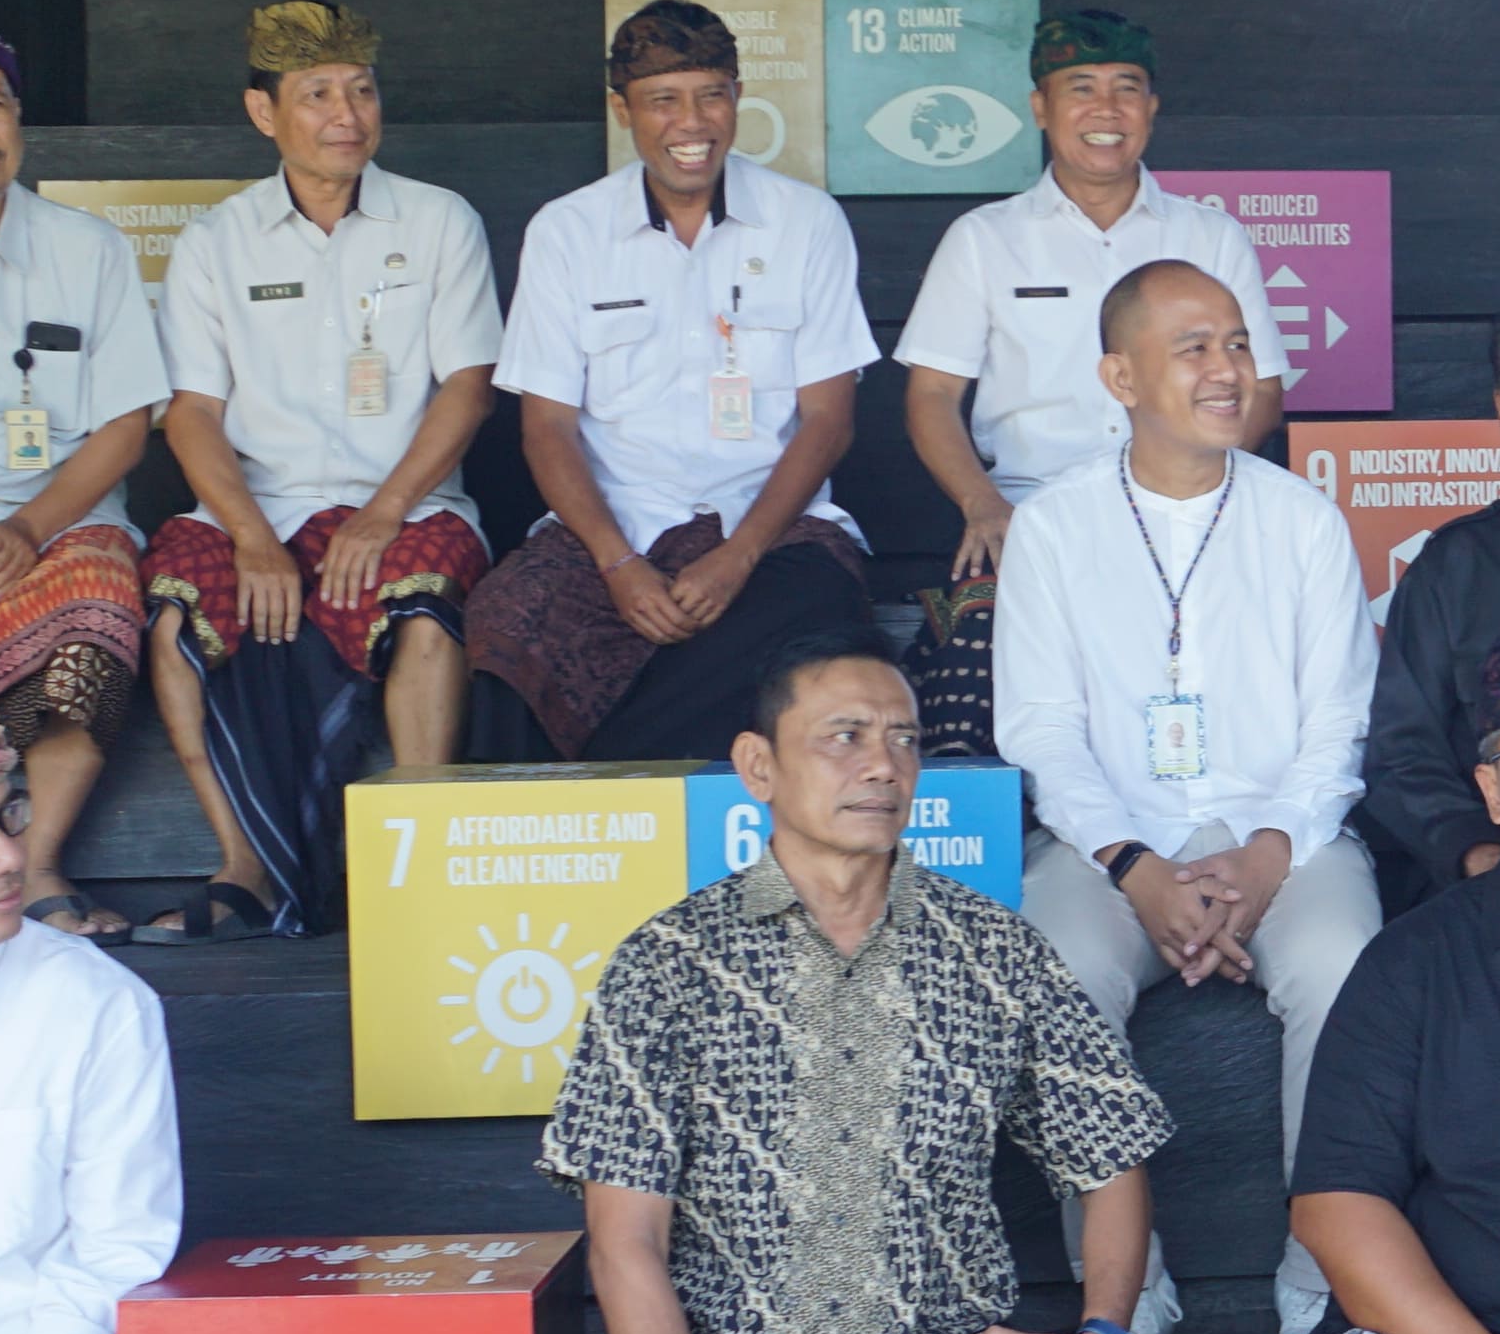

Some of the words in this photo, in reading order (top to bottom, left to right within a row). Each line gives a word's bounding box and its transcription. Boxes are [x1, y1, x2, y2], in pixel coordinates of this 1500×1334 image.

[719, 11, 777, 29] NSIBLE
[898, 8, 963, 27] CLIMATE
[847, 7, 886, 54] 13
[899, 33, 956, 53] ACTION
[739, 62, 806, 80] DUCTION
[1239, 194, 1318, 216] REDUCED
[1243, 223, 1350, 247] NEQUALITIES
[1350, 449, 1443, 476] INDUSTRY,
[1306, 450, 1337, 501] 9
[1351, 482, 1390, 507] AND
[908, 798, 950, 828] TER
[445, 814, 600, 847] AFFORDABLE
[605, 812, 656, 842] AND
[725, 803, 761, 871] 6
[384, 818, 416, 887] 7
[448, 855, 526, 886] CLEAN
[530, 852, 622, 884] ENERGY
[301, 1271, 435, 1282] POVERTY
[384, 1277, 427, 1287] NO
[467, 1270, 496, 1285] 1
